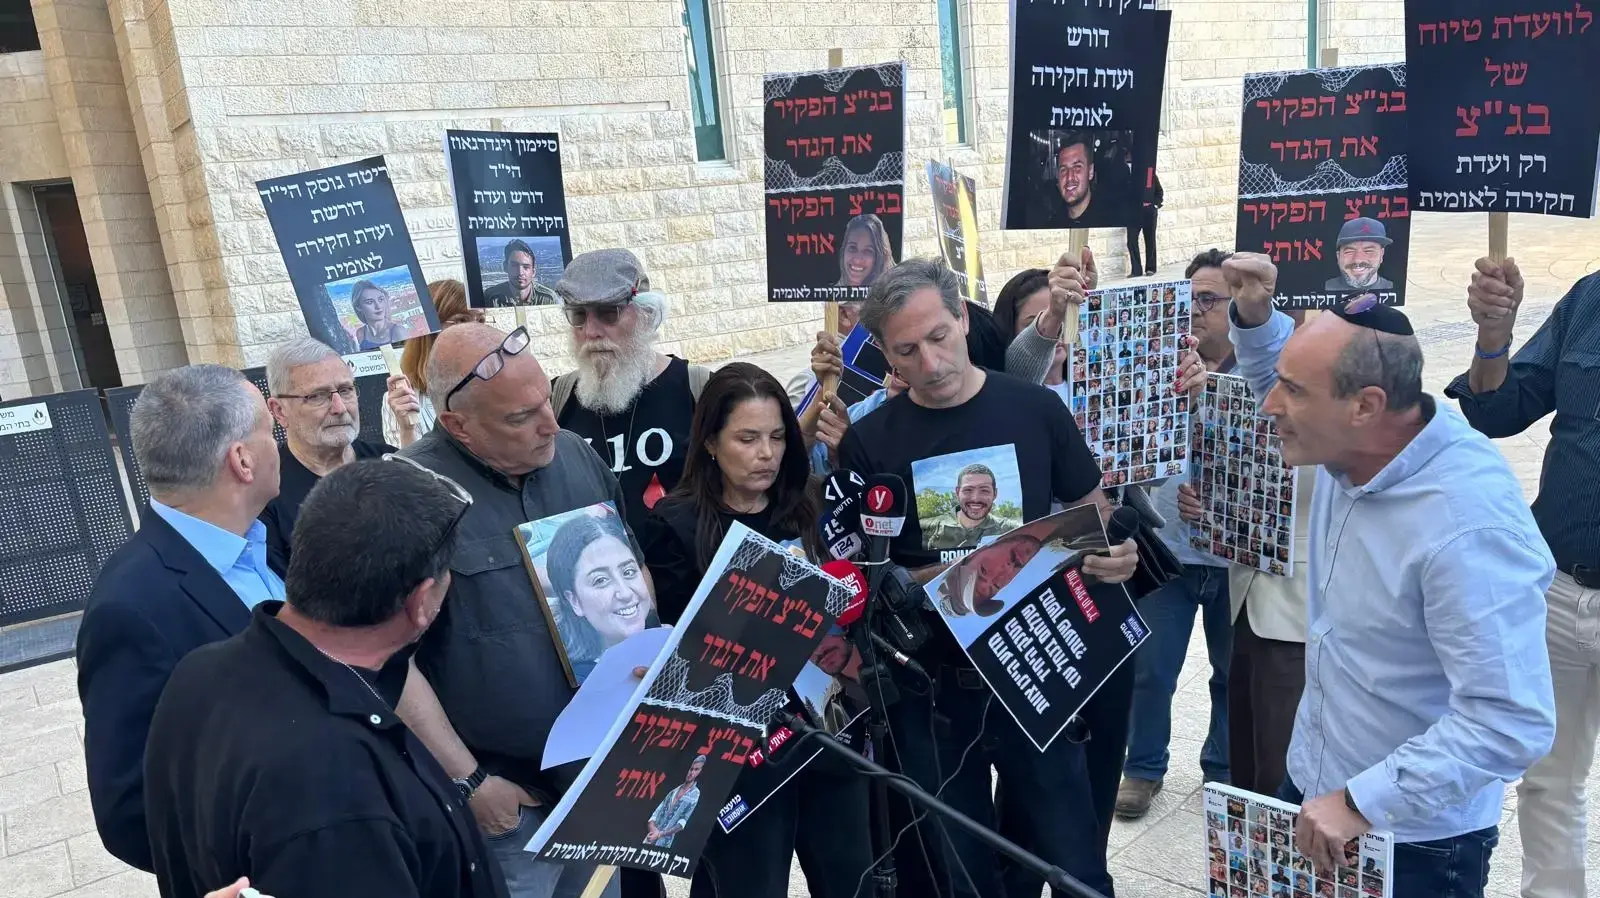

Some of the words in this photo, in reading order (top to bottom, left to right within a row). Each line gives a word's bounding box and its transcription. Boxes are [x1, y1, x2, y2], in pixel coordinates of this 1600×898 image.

[1418, 18, 1482, 45] טיוח
[1492, 2, 1593, 40] לוועדת
[1067, 26, 1110, 48] דורש
[1032, 65, 1088, 93] חקירה
[1094, 68, 1134, 90] ועדת
[1484, 57, 1528, 86] של
[773, 96, 836, 124] הפקיר
[1050, 102, 1112, 126] לאומית
[1256, 95, 1336, 126] הפקיר
[515, 138, 558, 156] סיימון
[786, 136, 835, 158] הגדר
[841, 133, 872, 155] את
[1270, 138, 1332, 162] הגדר
[1340, 135, 1379, 158] את
[489, 163, 521, 178] הי"ד
[1456, 154, 1510, 174] ועדת
[1519, 153, 1546, 178] רק
[306, 176, 346, 199] גוסק
[348, 166, 390, 186] ריטה
[474, 190, 506, 204] ועדת
[510, 190, 544, 204] דורש
[1419, 185, 1498, 208] לאומית
[1506, 189, 1575, 214] חקירה
[310, 200, 366, 224] דורשת
[468, 212, 516, 230] לאומית
[769, 196, 834, 224] הפקיר
[1243, 200, 1326, 231] הפקיר
[354, 224, 394, 245] ועדת
[521, 216, 564, 232] חקירה
[295, 232, 350, 257] חקירה
[786, 232, 834, 256] אותי
[1263, 238, 1324, 262] אותי
[324, 252, 384, 280] לאומית
[772, 285, 810, 300] לאומית
[814, 286, 848, 300] חקירה
[850, 286, 870, 299] עדת
[1292, 293, 1336, 309] חקירה
[1378, 292, 1397, 304] רק
[583, 428, 674, 472] 10
[832, 497, 853, 517] חדשות
[875, 490, 886, 510] y
[866, 518, 892, 530] ynet
[724, 572, 780, 618] הפקיר
[1038, 587, 1066, 623] במשך
[1056, 618, 1087, 660] שעות?
[700, 632, 745, 671] הגדר
[1004, 616, 1033, 653] הטנק
[1024, 646, 1051, 683] היחיד
[1020, 603, 1050, 645] שנלחם
[1044, 638, 1069, 673] בנחל
[1062, 666, 1082, 689] עוז
[738, 649, 776, 683] את
[988, 632, 1014, 666] מדוע
[1006, 658, 1031, 690] היינו
[1024, 683, 1050, 715] צוות
[632, 711, 697, 754] הפקיר
[616, 768, 666, 800] אותי
[719, 794, 741, 817] מועצת
[1366, 833, 1385, 842] פורום
[545, 840, 597, 860] לאומית
[595, 844, 637, 866] חקירה
[636, 848, 670, 868] ועדת
[667, 854, 690, 875] רק
